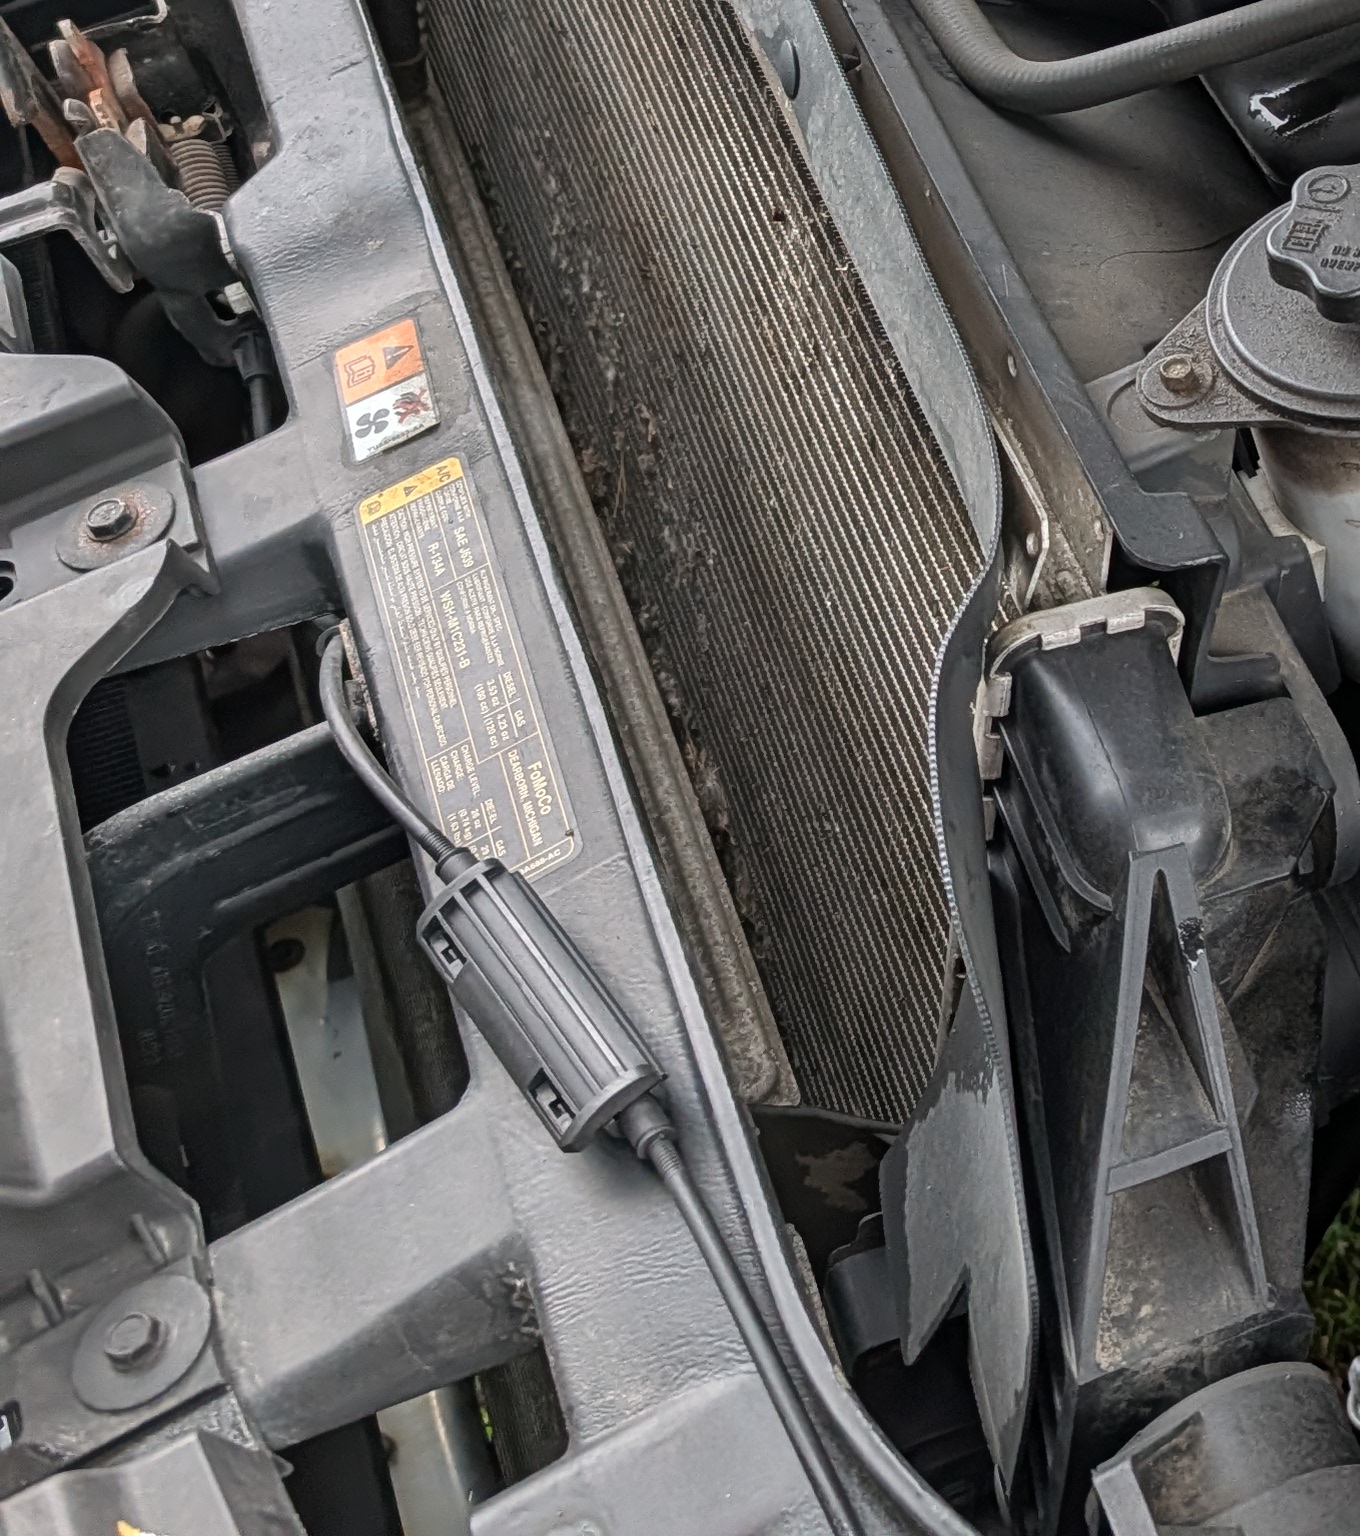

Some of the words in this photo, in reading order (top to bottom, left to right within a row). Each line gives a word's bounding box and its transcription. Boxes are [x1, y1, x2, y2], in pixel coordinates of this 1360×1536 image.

[435, 462, 451, 484] A/C
[453, 524, 468, 547] SAE
[426, 541, 446, 577] R-134A
[458, 543, 474, 569] J639
[438, 589, 471, 670] WSH-M1C231-B
[485, 677, 499, 697] 3.53
[495, 711, 509, 731] 4.23
[501, 669, 518, 699] DIESEL
[513, 708, 526, 728] GAS
[482, 716, 497, 736] (120
[487, 733, 500, 750] cc)
[438, 754, 453, 781] CARGA
[448, 748, 466, 783] CHARGE:
[459, 742, 475, 774] CHARGE
[467, 771, 482, 798] LEVEL:
[444, 778, 456, 792] DE
[506, 748, 530, 803] DEARBORN,
[521, 799, 543, 847] MICHIGAN
[526, 759, 555, 817] FoMoCo
[483, 797, 499, 825] DIESEL
[494, 838, 507, 857] GAS
